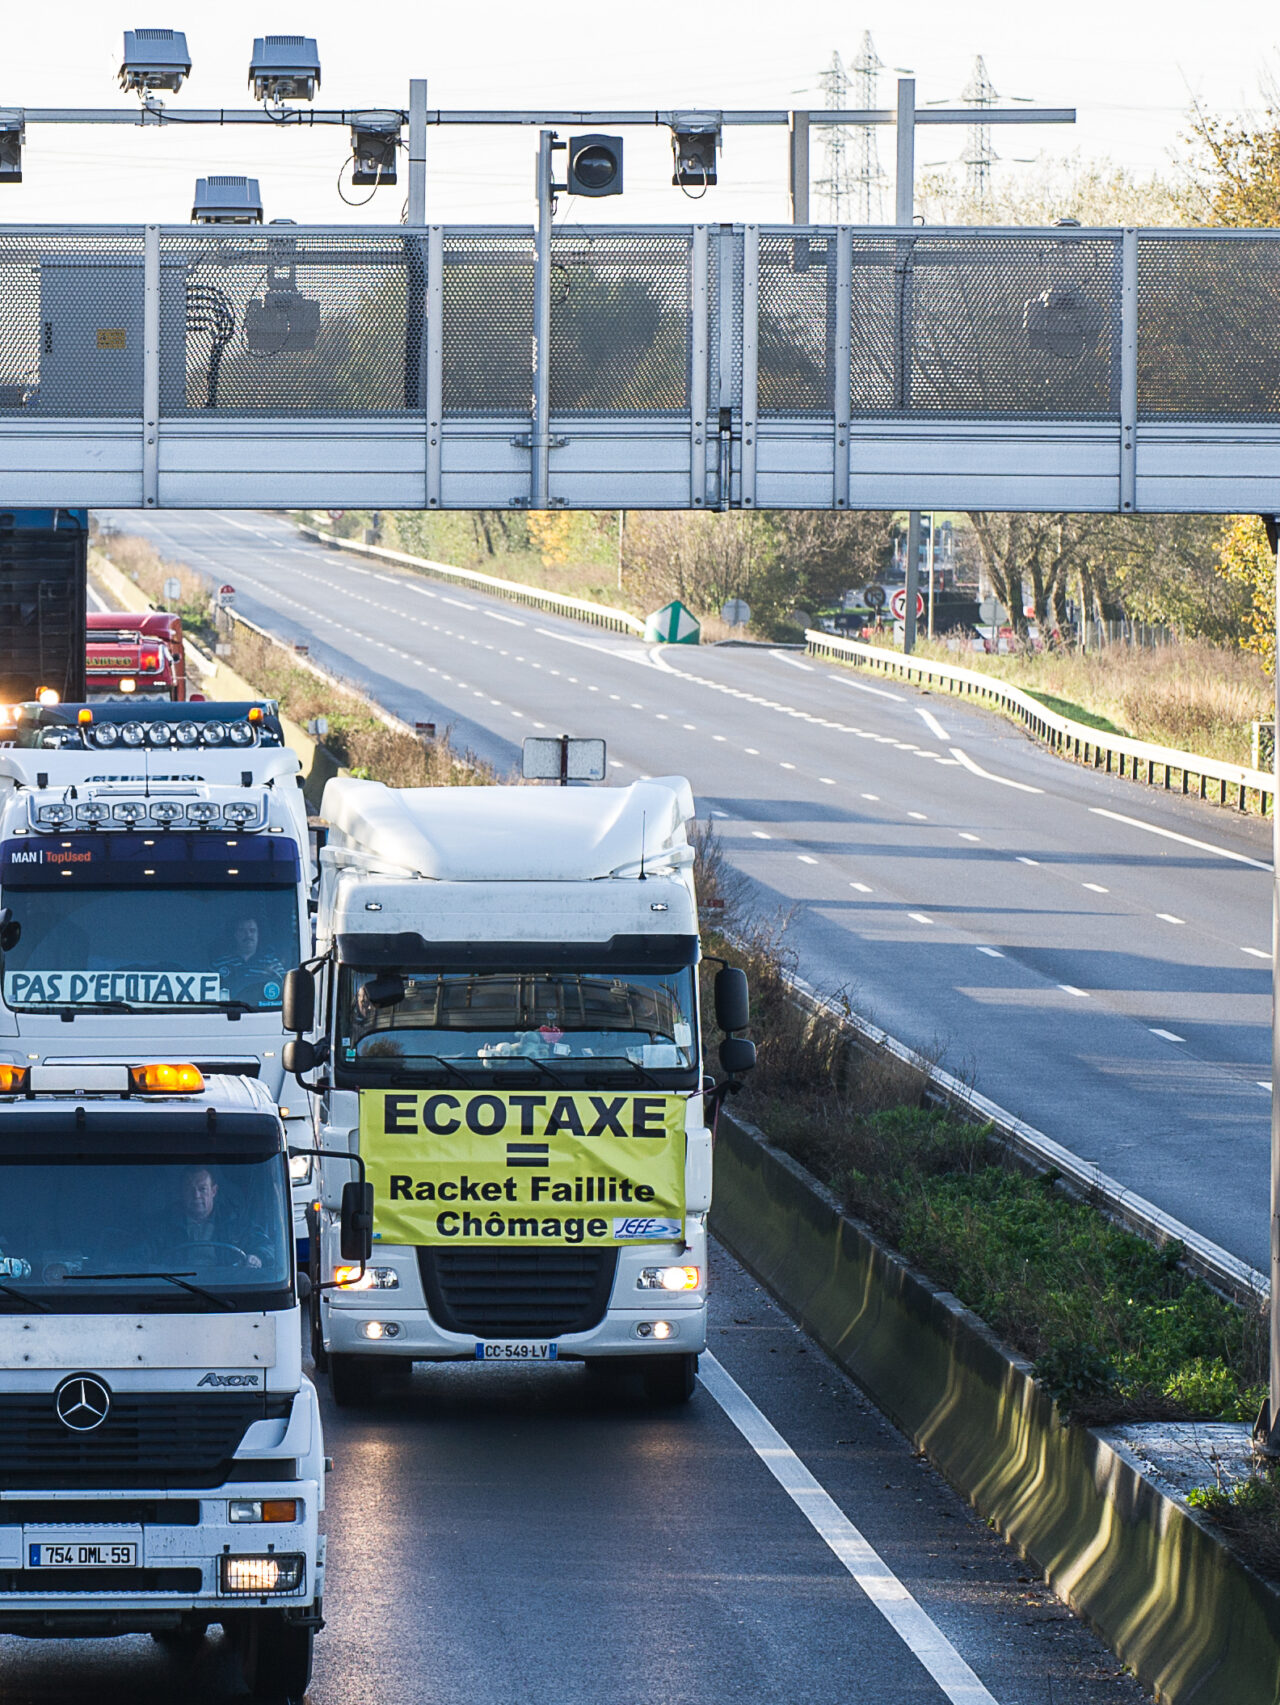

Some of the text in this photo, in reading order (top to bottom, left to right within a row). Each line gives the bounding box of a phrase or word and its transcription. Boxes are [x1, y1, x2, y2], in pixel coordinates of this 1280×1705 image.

[11, 851, 91, 863] MAN TopUsed
[11, 974, 62, 1001] PAS
[384, 1094, 667, 1138] ECOTAXE
[390, 1175, 655, 1202] Racket Faillite
[436, 1210, 657, 1244] Chômage JEFF
[485, 1344, 548, 1358] CC-549-LV
[45, 1546, 131, 1564] 754 DML 59
